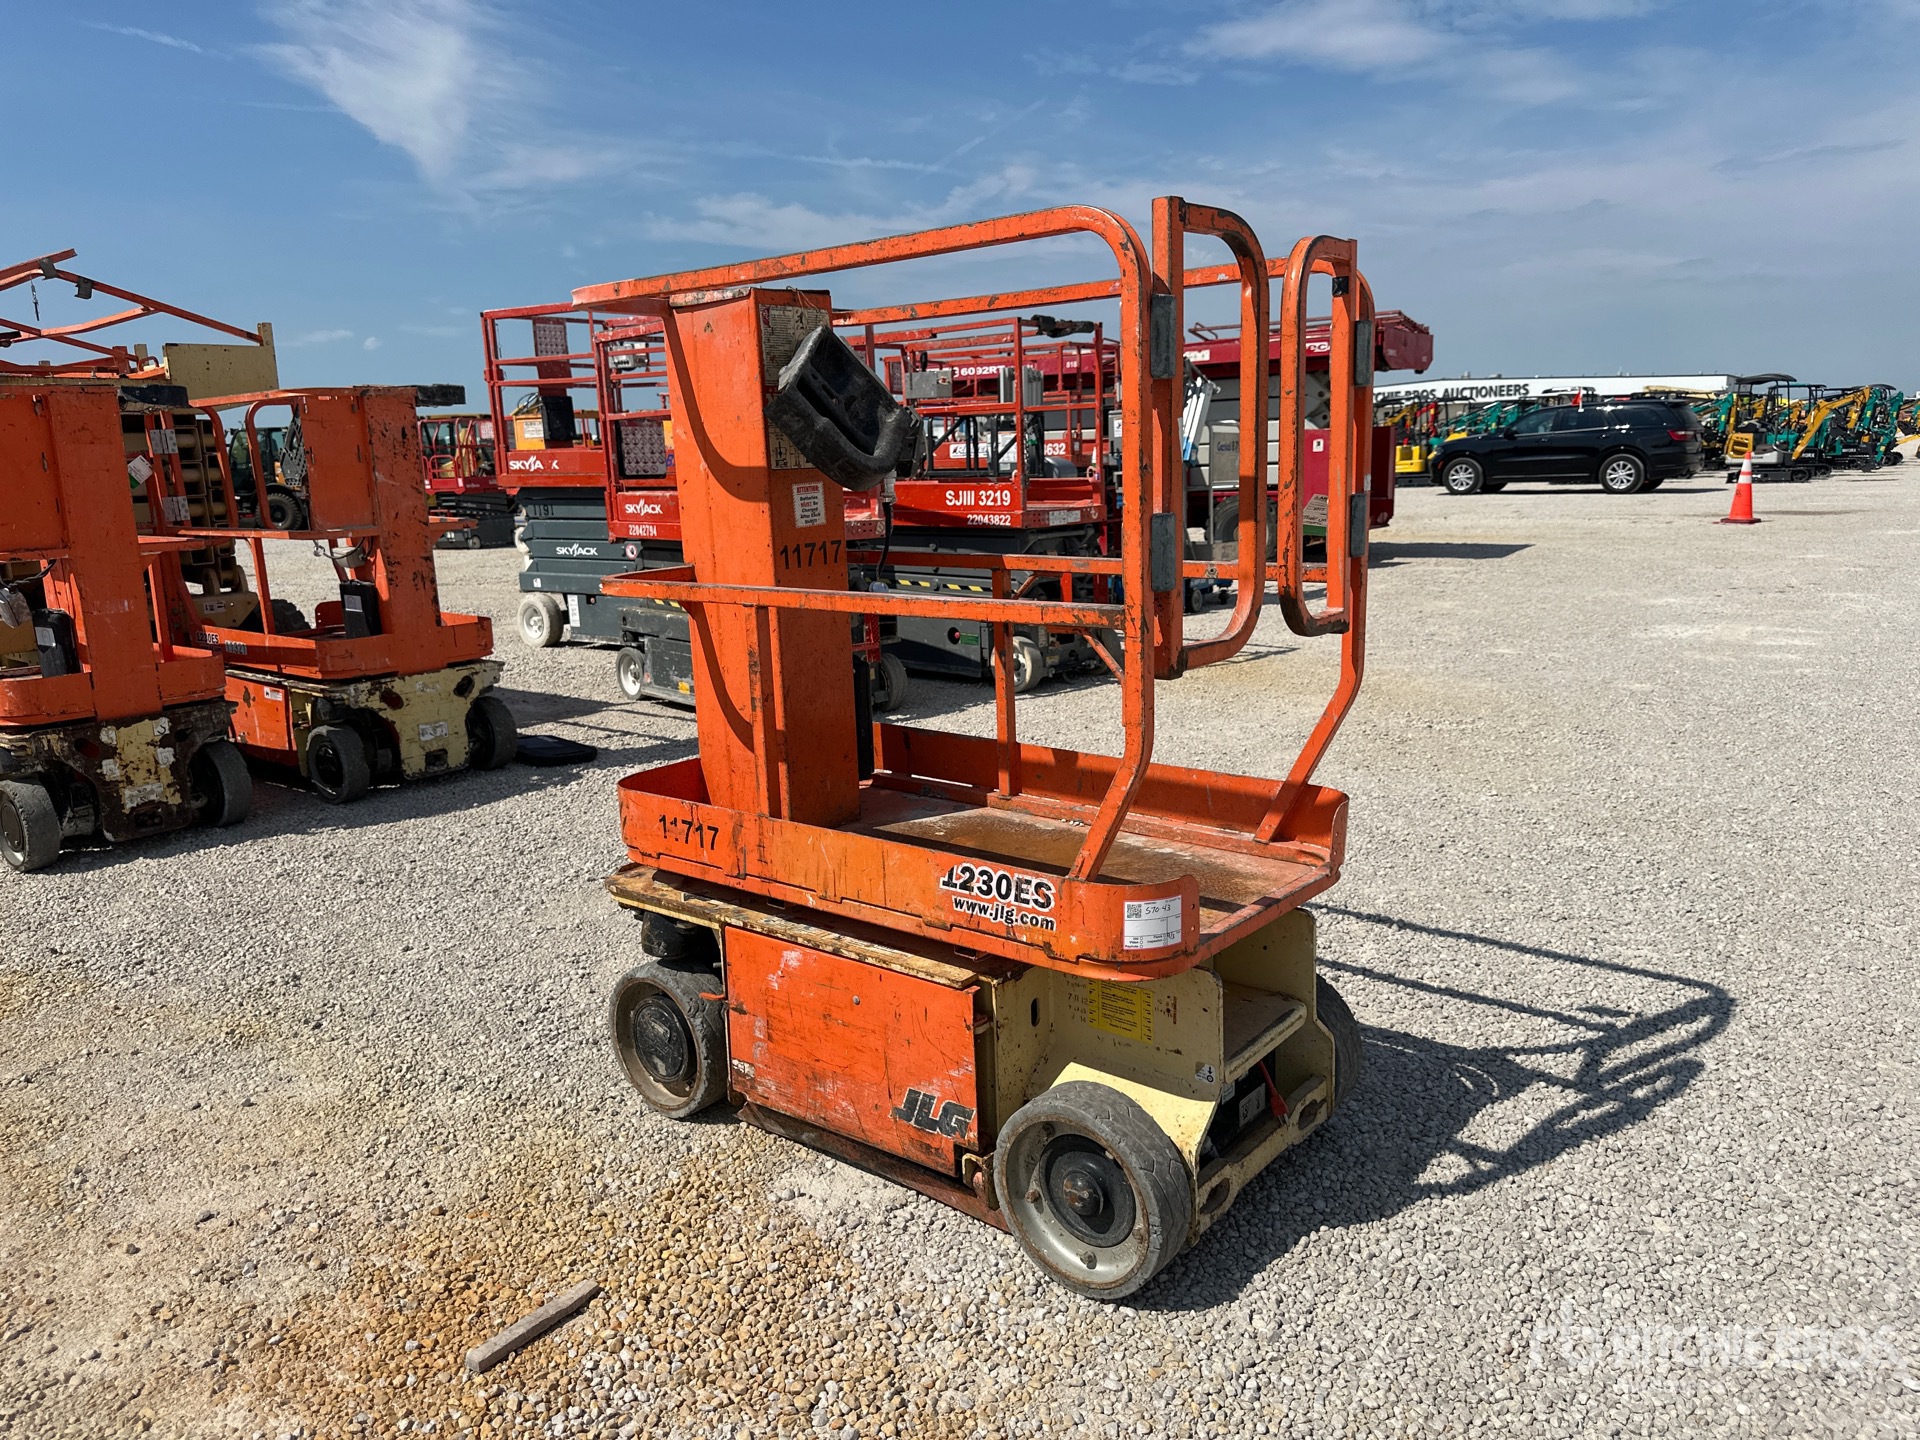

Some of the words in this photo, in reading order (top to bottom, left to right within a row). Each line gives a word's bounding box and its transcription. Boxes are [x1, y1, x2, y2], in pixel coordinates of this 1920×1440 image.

[1443, 383, 1530, 400] AUCTIONEERS
[509, 455, 560, 471] SKYJAK
[945, 490, 975, 506] SJIII
[978, 490, 1011, 506] 3219
[625, 498, 663, 516] SKYJACK
[966, 514, 1011, 526] 22043822
[628, 524, 658, 537] 22042794
[556, 543, 598, 557] SKYJACK
[780, 539, 842, 570] 11717
[659, 814, 719, 851] 11717
[941, 864, 1054, 910] 1230ES
[954, 897, 1055, 931] www.jlg.com
[890, 1087, 976, 1140] JLG
